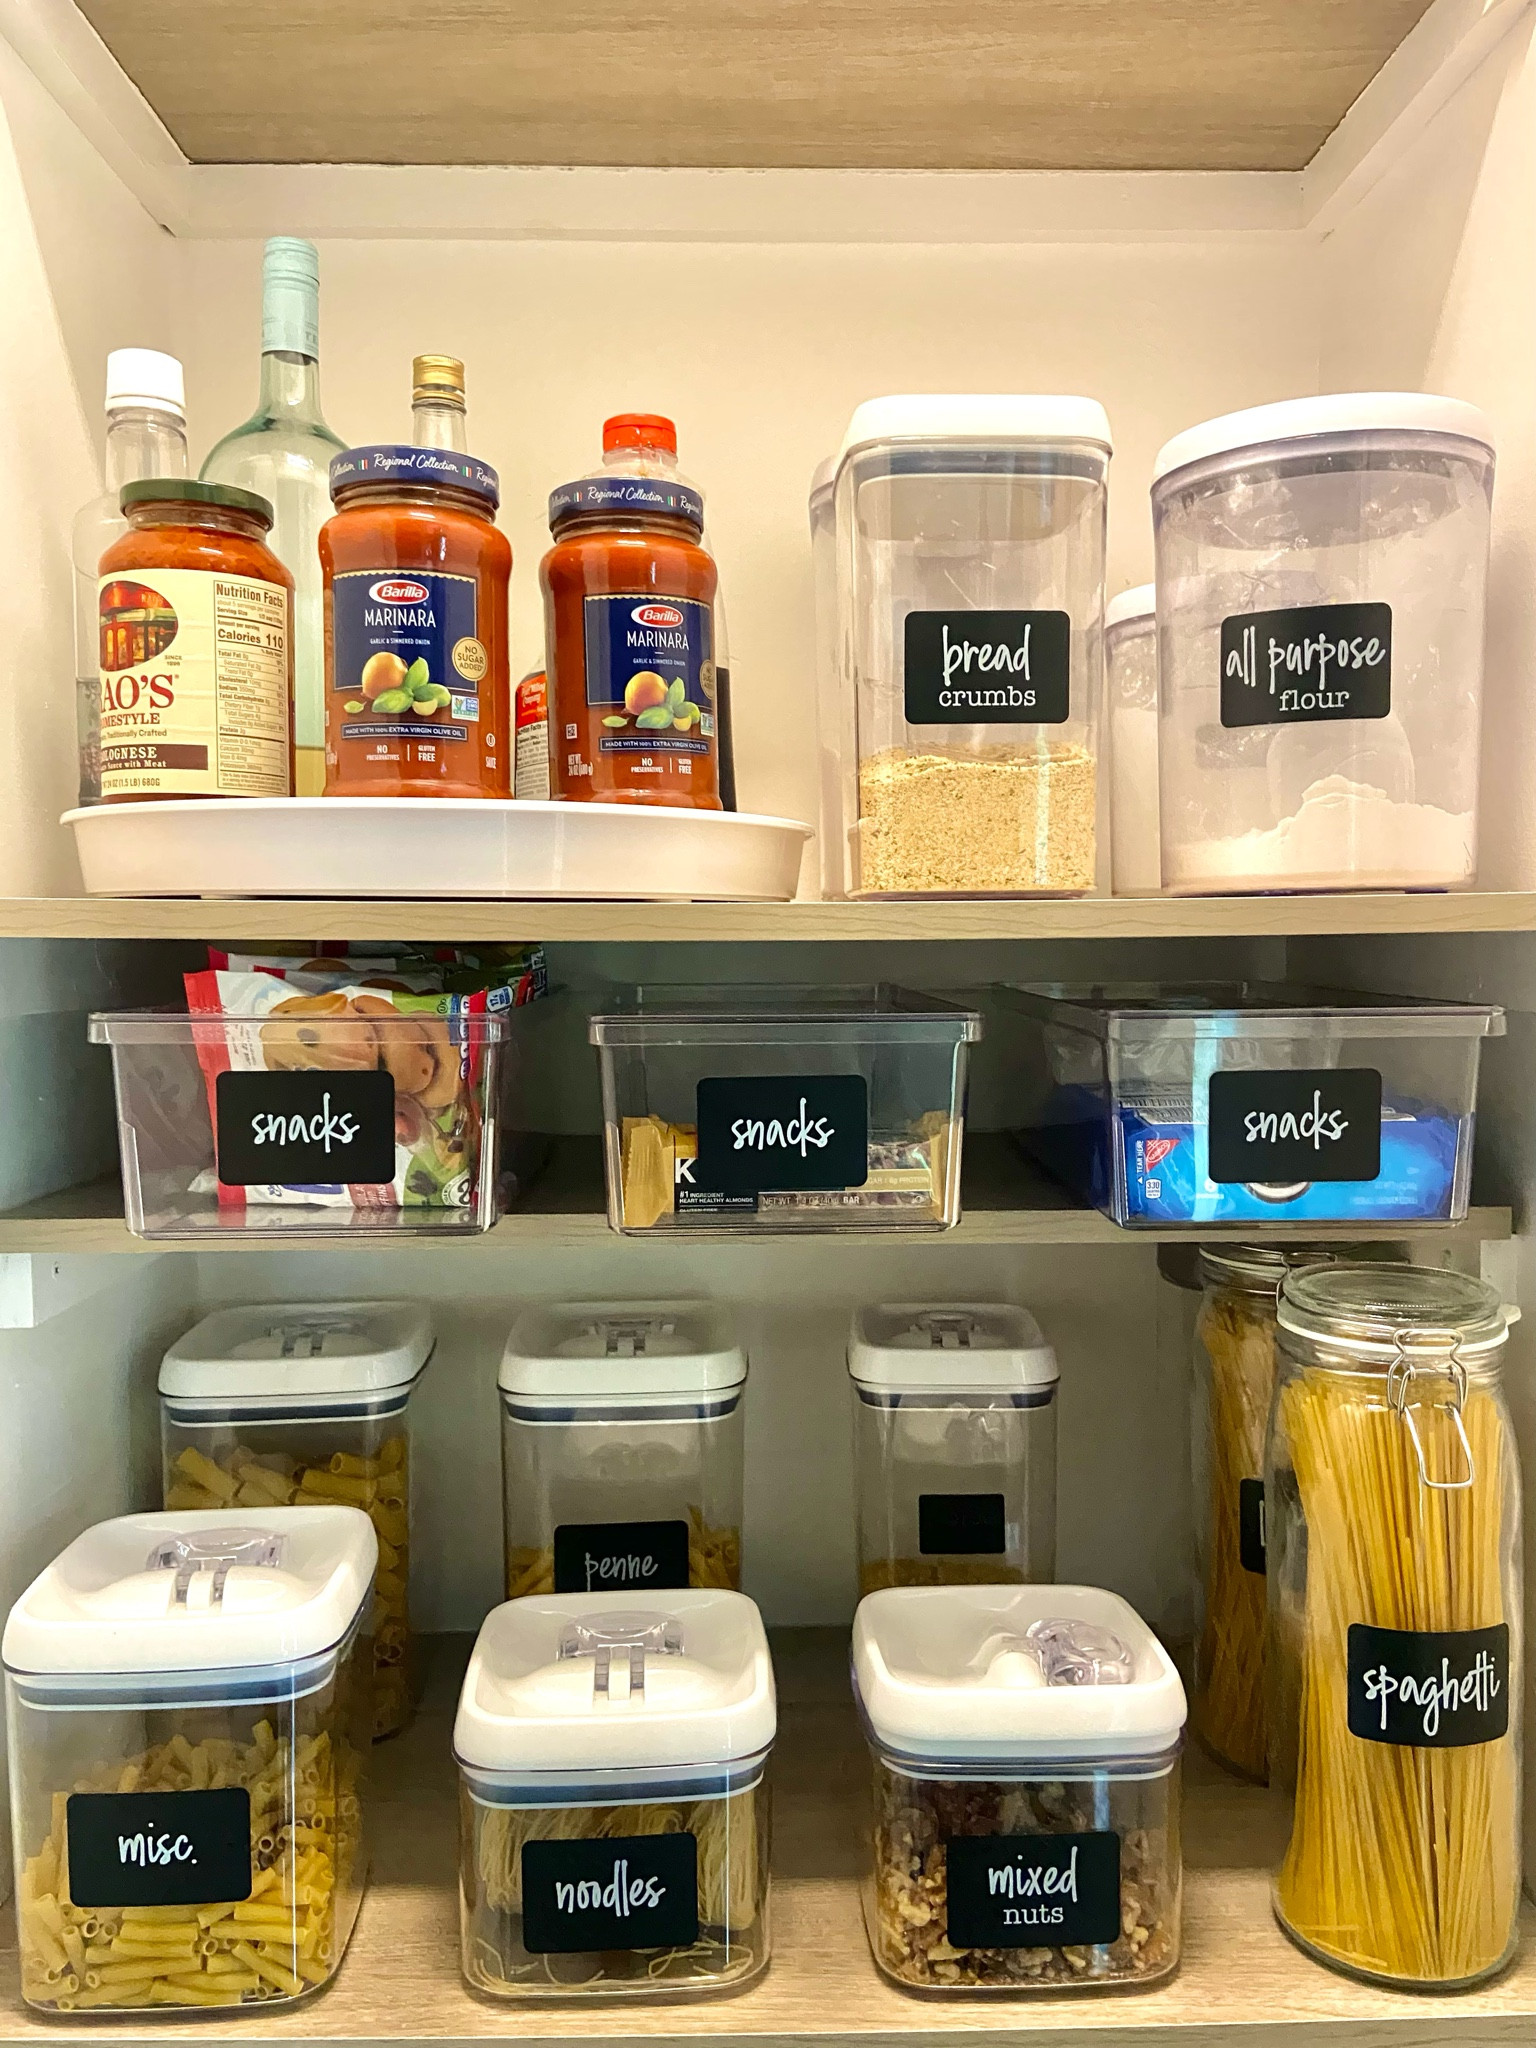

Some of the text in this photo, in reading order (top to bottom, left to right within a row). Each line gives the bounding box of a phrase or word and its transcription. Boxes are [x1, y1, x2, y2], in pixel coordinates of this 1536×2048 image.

[374, 453, 458, 473] Regional Collection
[588, 486, 625, 503] Regional
[626, 487, 664, 503] Collection
[216, 583, 283, 608] Nutrition Facts
[382, 585, 423, 598] Barilla
[364, 608, 436, 628] MARINARA
[643, 610, 679, 622] Barilla
[218, 628, 283, 649] Calories 110
[627, 631, 689, 651] MARINARA
[457, 653, 484, 665] SUGAR
[464, 645, 477, 654] NO
[942, 623, 1031, 687] bread
[1226, 625, 1386, 695] all purpose
[101, 674, 174, 713] AO'S
[938, 686, 1036, 707] crumbs
[1279, 689, 1350, 711] flour
[101, 713, 160, 729] MESTYLE
[433, 728, 451, 736] OLIVE
[101, 746, 158, 761] LOGNESE
[376, 744, 388, 753] NO
[418, 752, 436, 762] FREE
[124, 760, 141, 768] with
[144, 760, 167, 768] Meat
[641, 758, 653, 767] NO
[678, 765, 692, 774] FREE
[142, 778, 160, 786] 680G
[251, 1092, 361, 1153] snacks
[730, 1097, 835, 1158] snacks
[1243, 1089, 1349, 1150] snacks
[1147, 1181, 1160, 1189] 330
[763, 1197, 777, 1205] NET
[778, 1197, 791, 1205] WT
[843, 1196, 860, 1204] BAR
[585, 1552, 658, 1592] penne
[1363, 1650, 1500, 1737] spaghetti
[118, 1822, 198, 1867] misc.
[988, 1846, 1078, 1903] mixed
[556, 1859, 666, 1917] noodles
[1003, 1903, 1065, 1925] nuts
